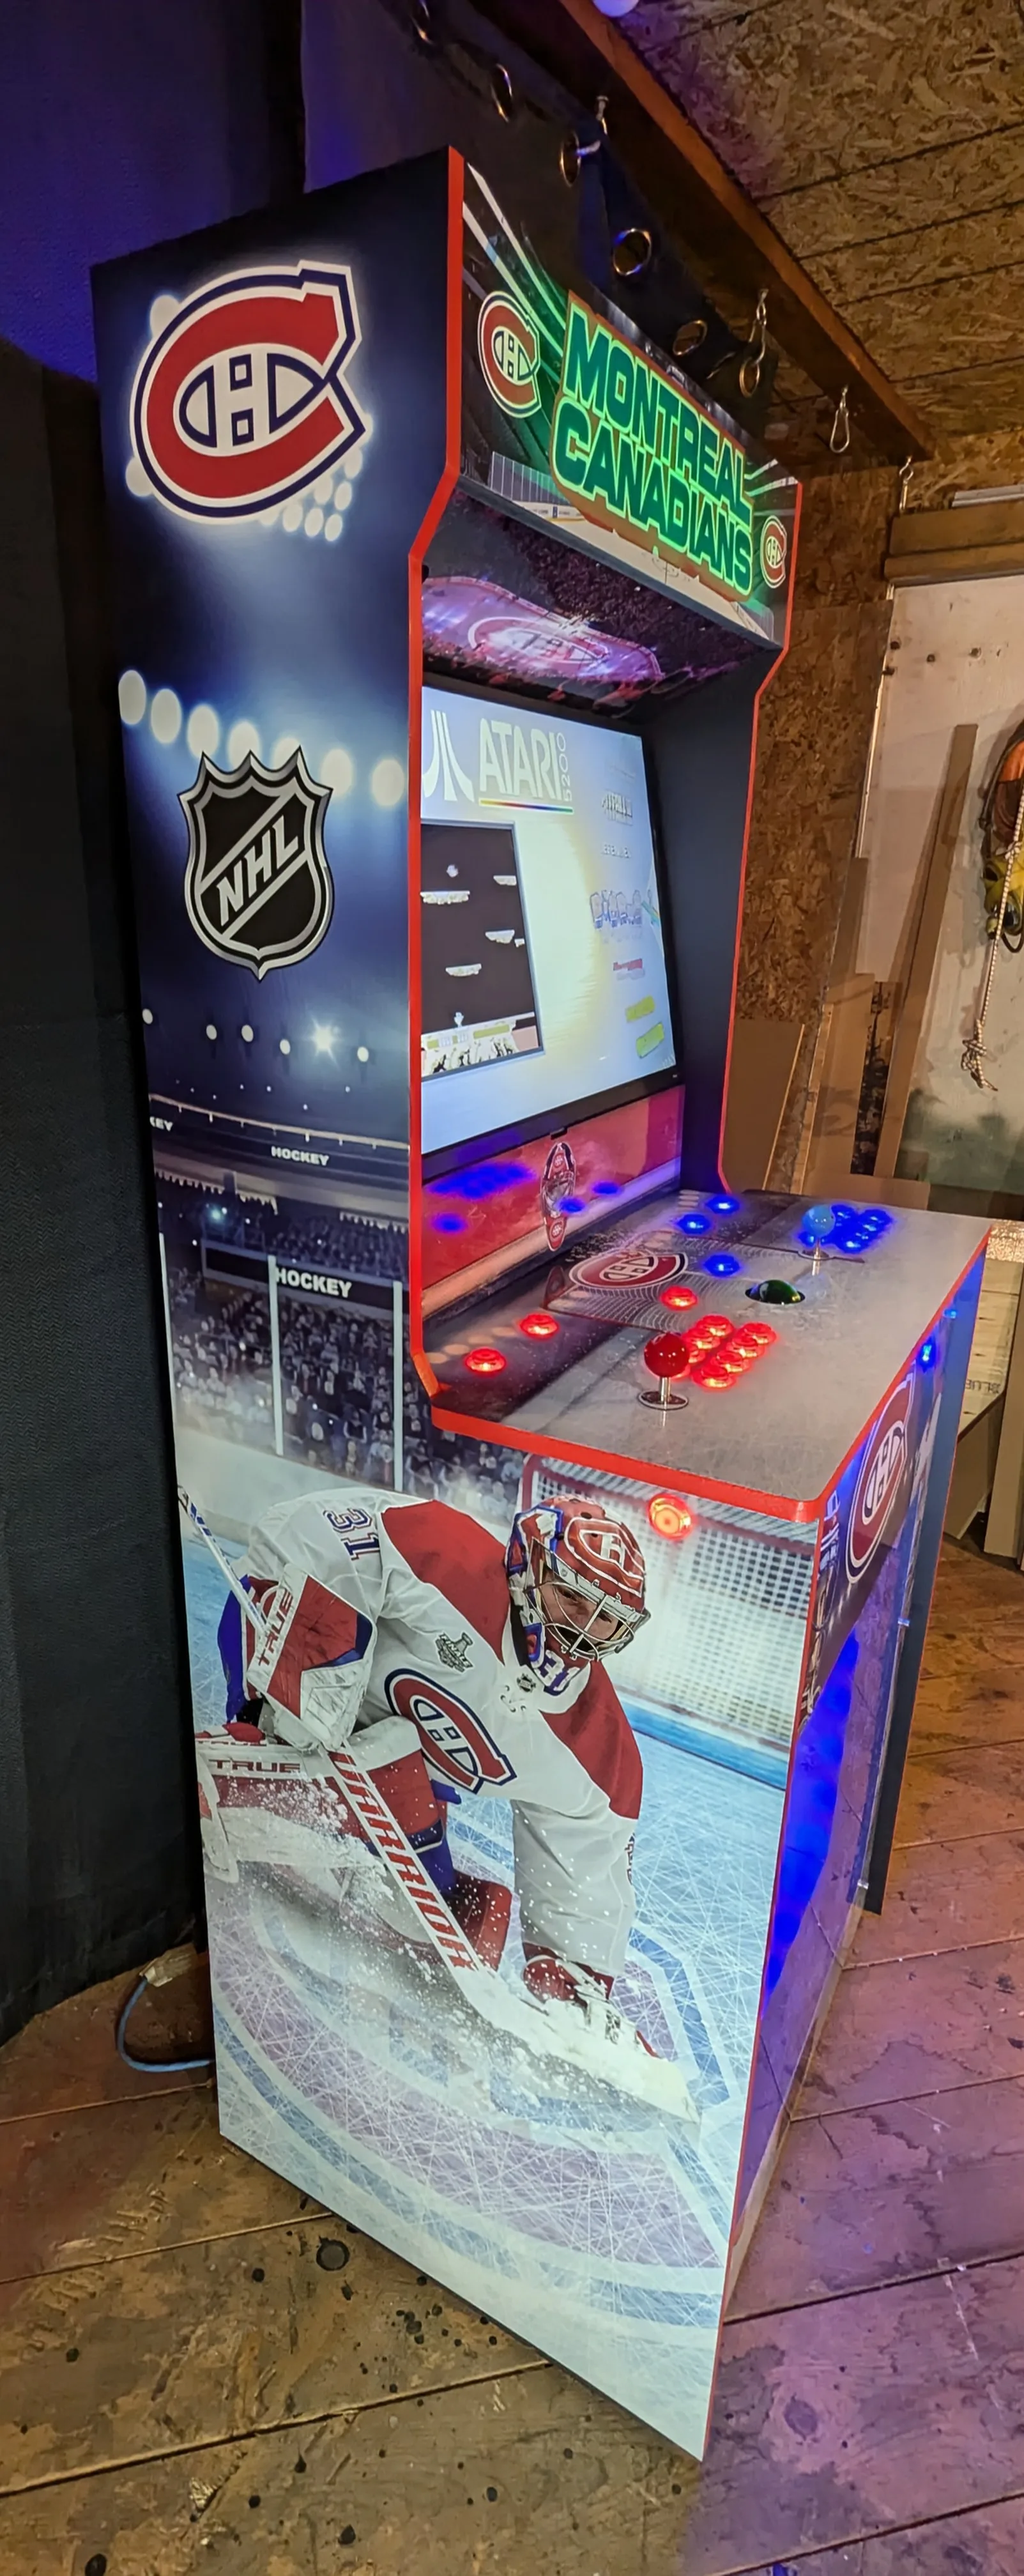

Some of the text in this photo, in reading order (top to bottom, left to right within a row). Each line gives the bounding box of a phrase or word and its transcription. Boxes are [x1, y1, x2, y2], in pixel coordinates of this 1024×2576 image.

[562, 302, 753, 532] MONTREAL
[553, 396, 753, 596] CANADIANS
[479, 717, 563, 801] ATARI
[557, 732, 573, 802] 5200
[217, 815, 299, 926] NHL
[270, 1146, 330, 1167] HOCKEY
[275, 1267, 353, 1298] HOCKEY
[323, 1507, 381, 1561] 31
[257, 1587, 294, 1667] TRUE
[534, 1649, 580, 1692] 31
[208, 1758, 301, 1774] TRUE
[327, 1751, 480, 1973] WARRIOR
